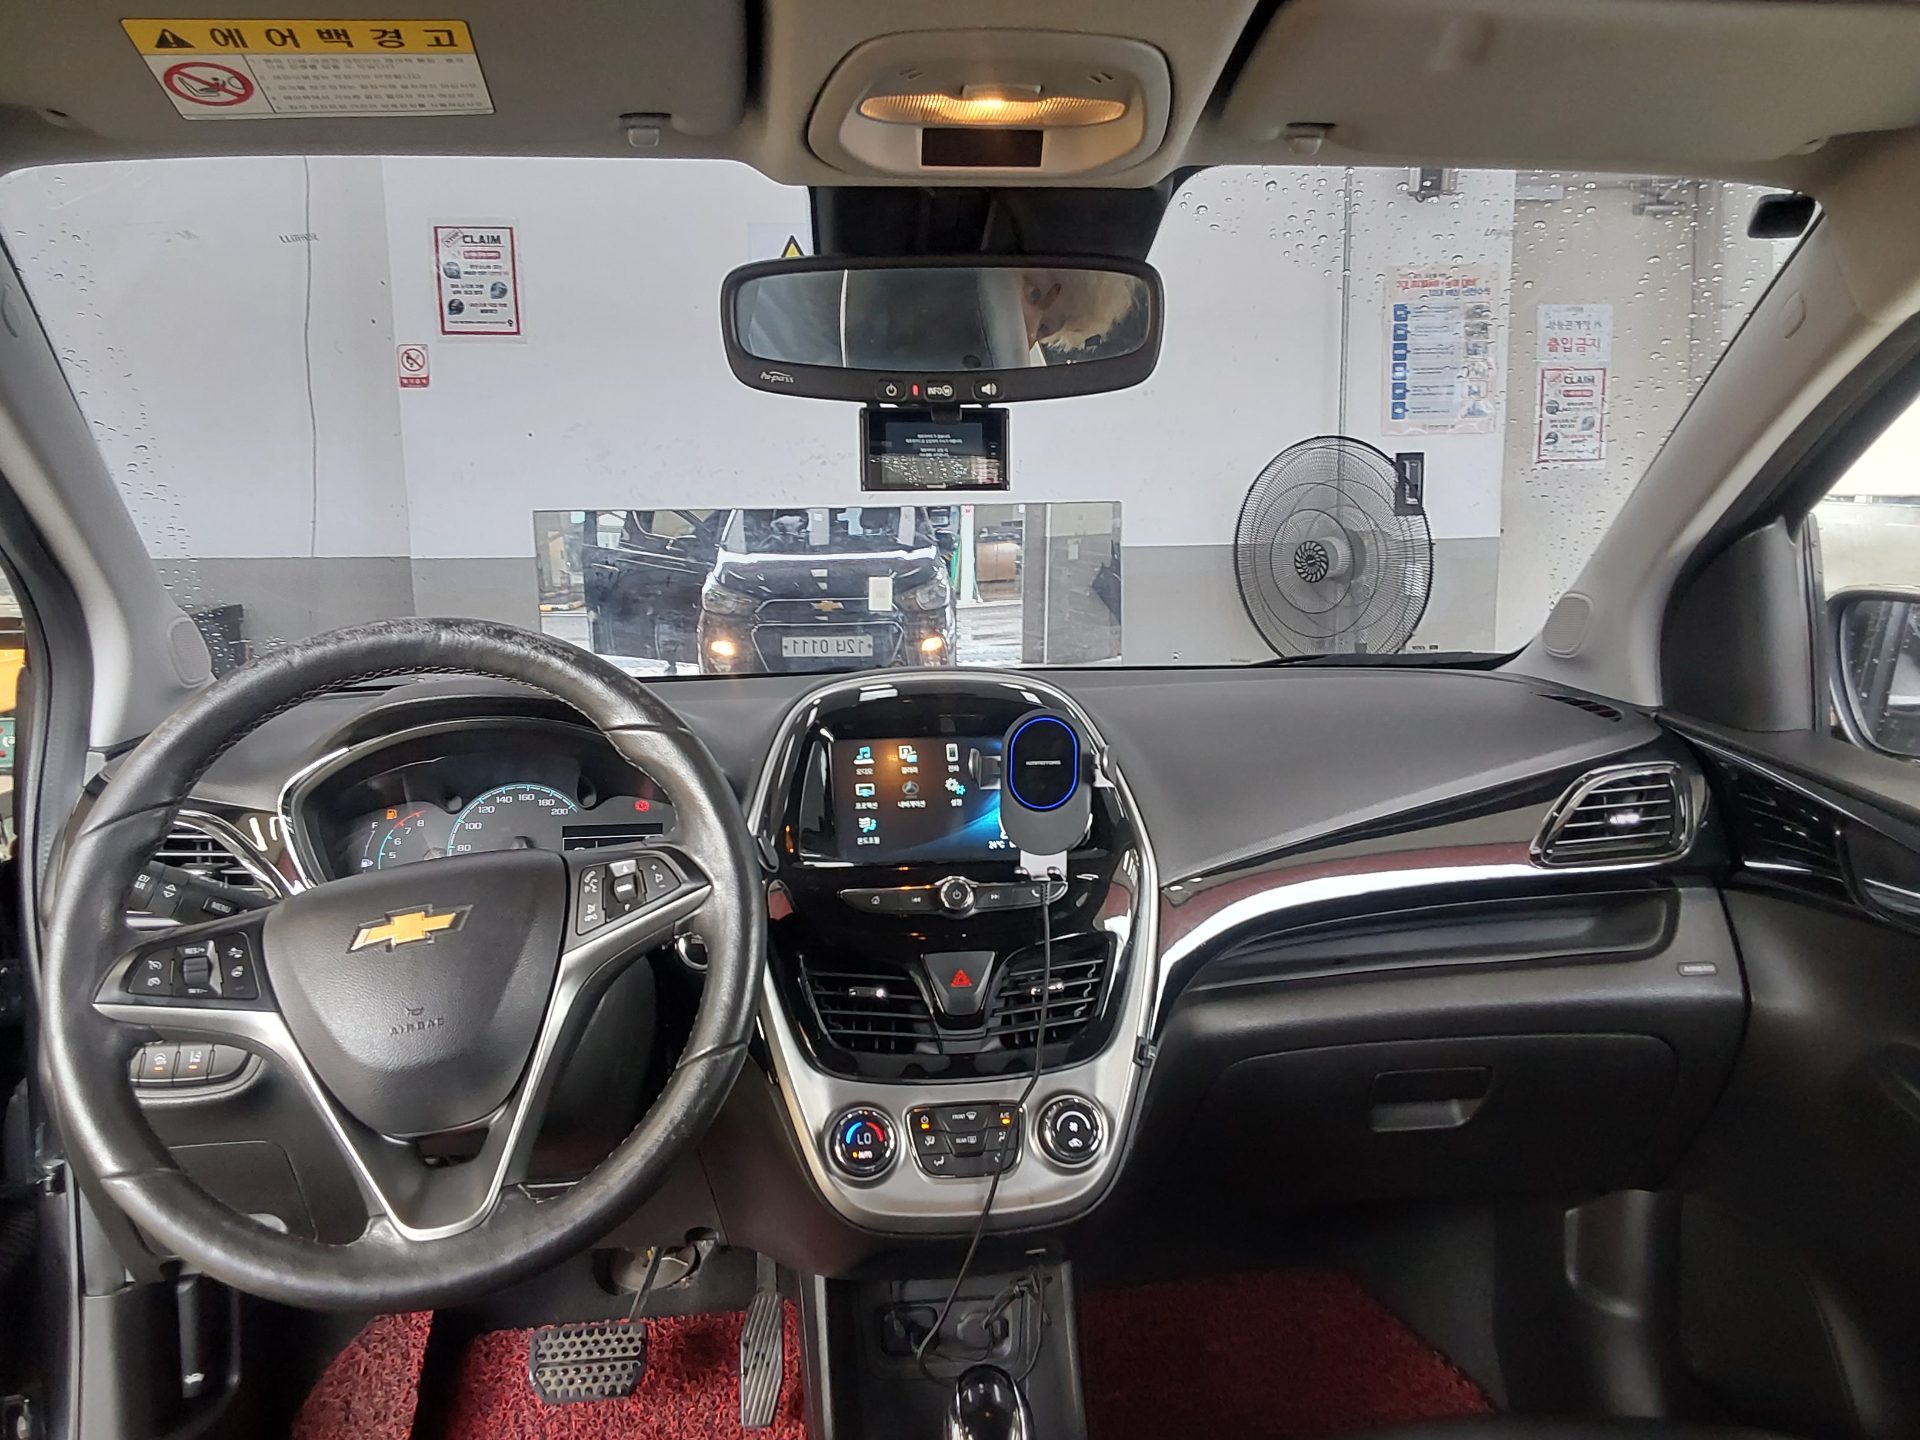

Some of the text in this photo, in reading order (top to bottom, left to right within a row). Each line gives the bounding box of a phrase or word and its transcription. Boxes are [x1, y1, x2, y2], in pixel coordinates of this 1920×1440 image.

[462, 234, 502, 244] CLAIM
[1547, 337, 1601, 353] 출입금지
[518, 793, 535, 801] 160
[538, 798, 555, 806] 180
[416, 819, 425, 827] 8
[465, 822, 482, 830] 100
[404, 827, 412, 835] 7
[394, 837, 402, 845] 6
[457, 844, 472, 852] 80
[388, 851, 397, 859] 5
[211, 901, 232, 913] MENU
[390, 1017, 446, 1036] AIRBAG
